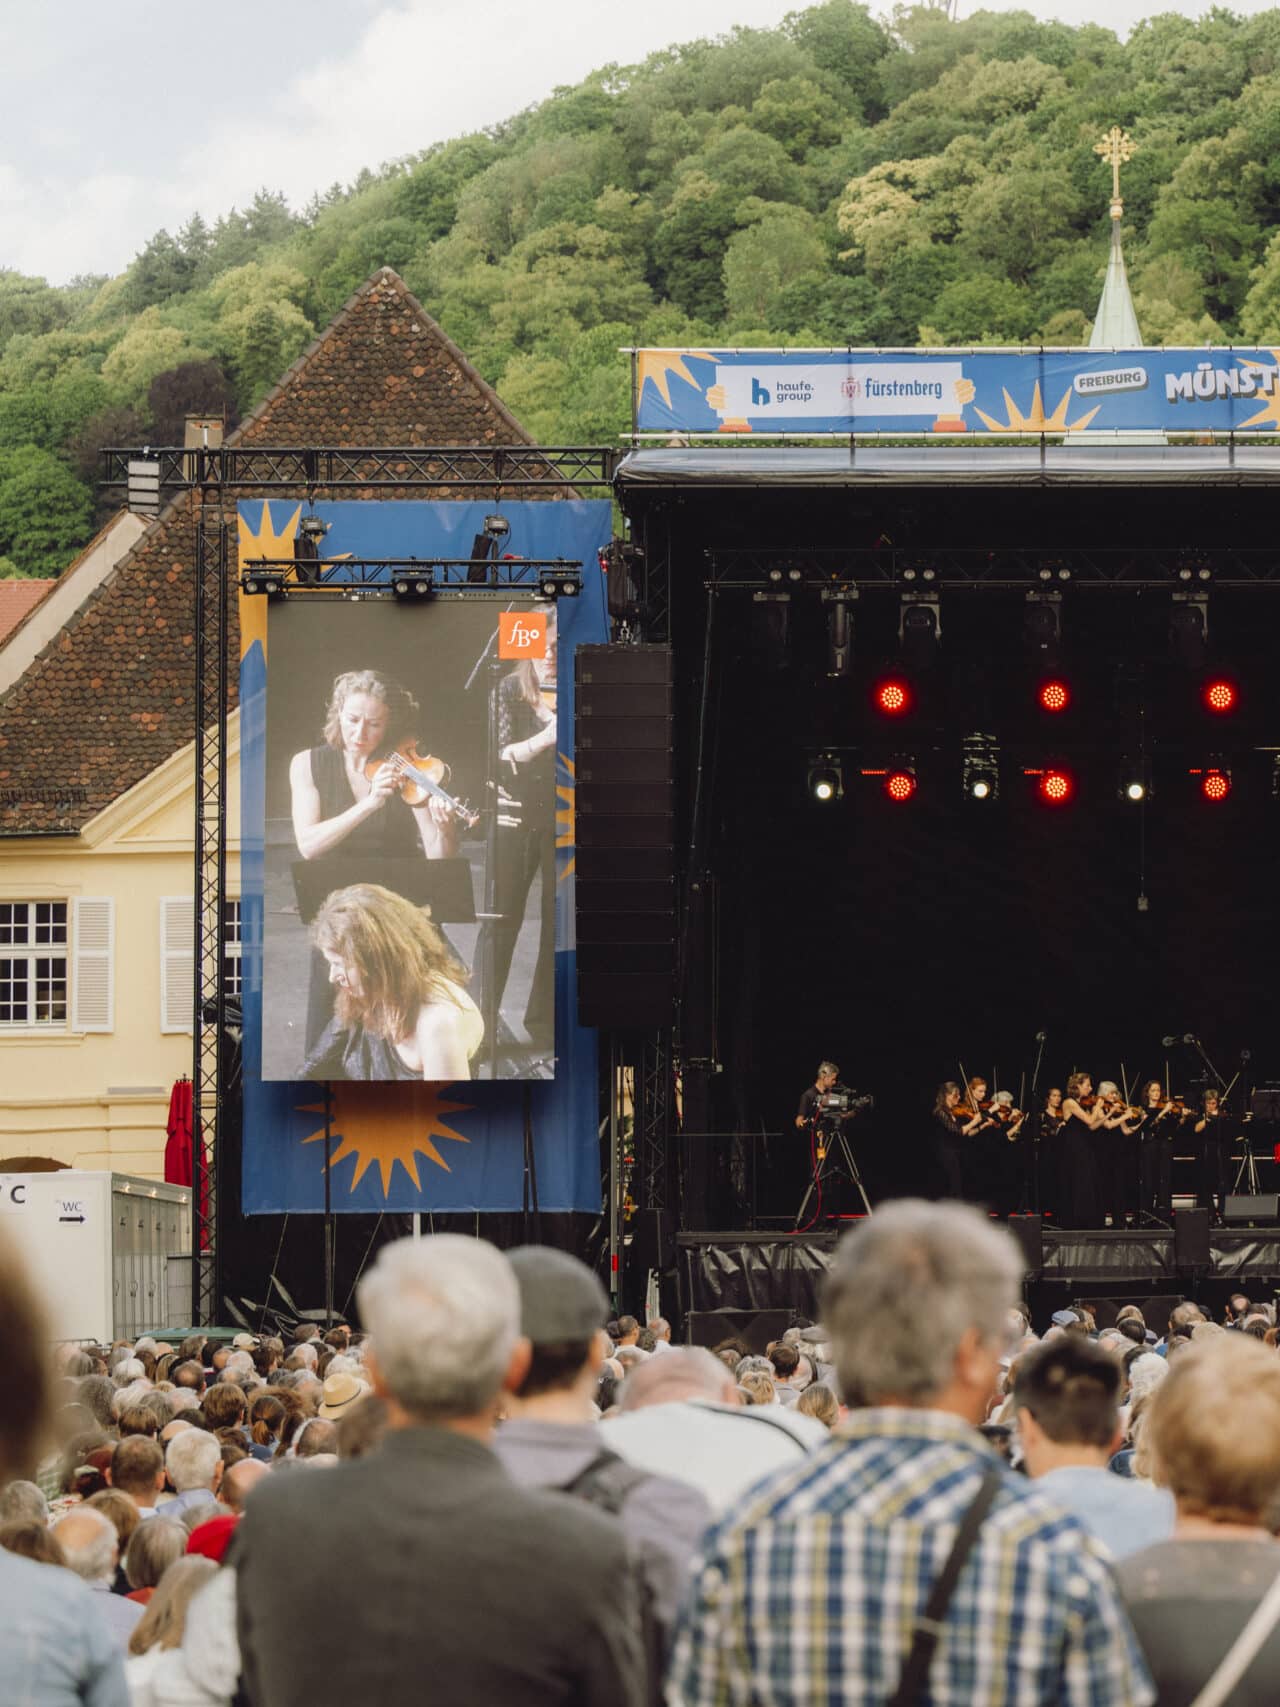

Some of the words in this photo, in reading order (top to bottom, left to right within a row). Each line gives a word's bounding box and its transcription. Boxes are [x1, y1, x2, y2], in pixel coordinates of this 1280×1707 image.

[1079, 372, 1142, 388] FREIBURG
[865, 378, 942, 399] fürstenberg
[776, 392, 812, 403] group
[62, 1201, 82, 1212] WC
